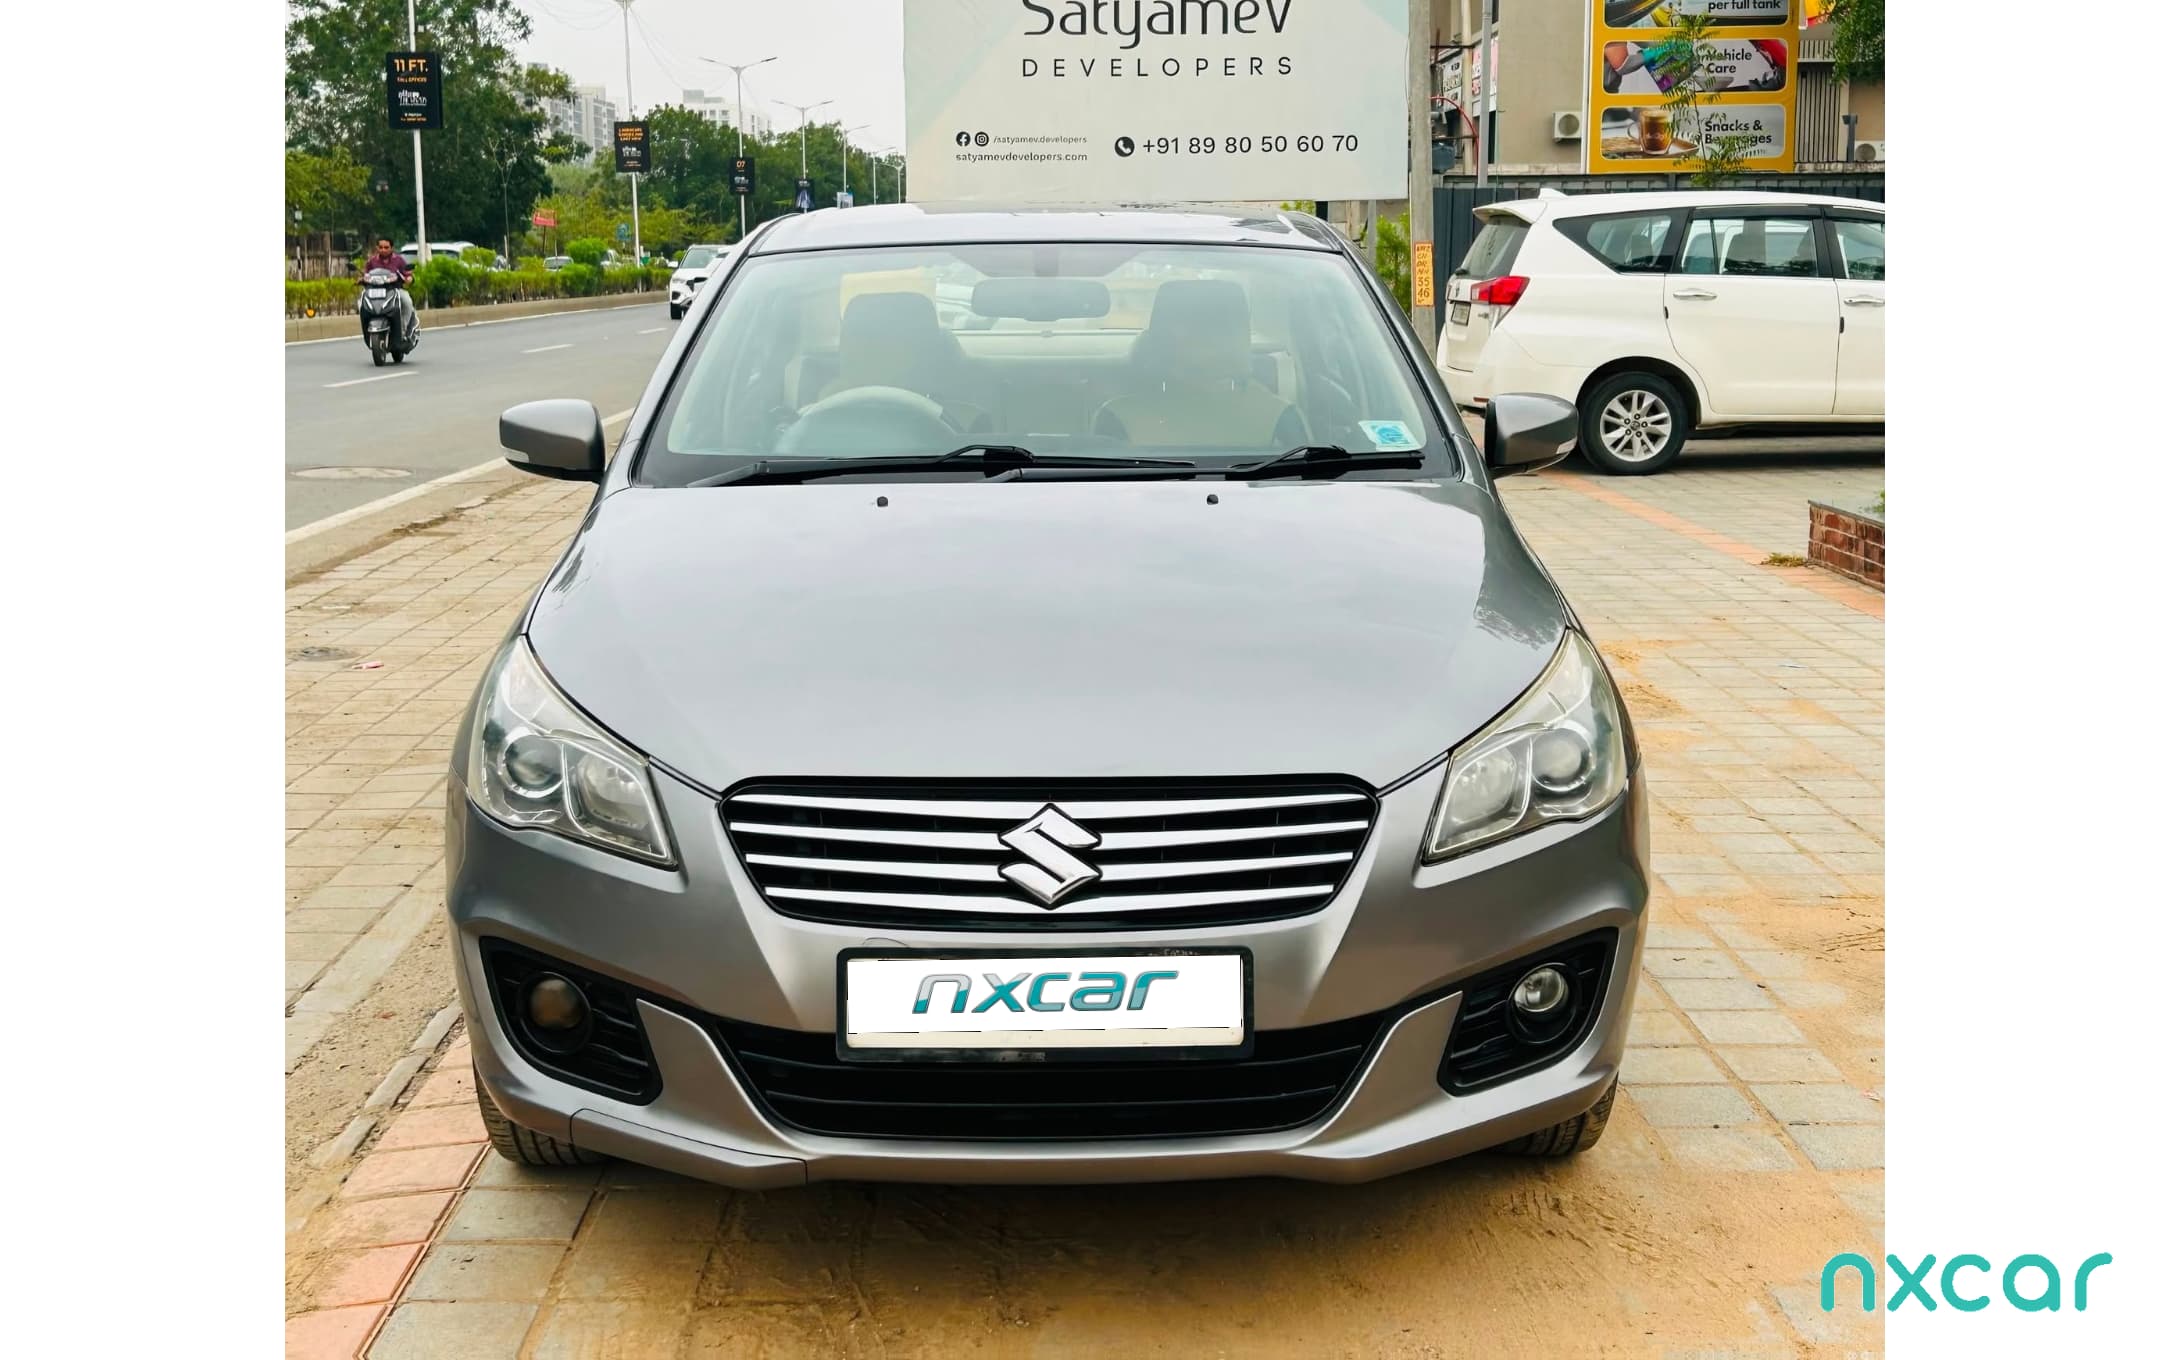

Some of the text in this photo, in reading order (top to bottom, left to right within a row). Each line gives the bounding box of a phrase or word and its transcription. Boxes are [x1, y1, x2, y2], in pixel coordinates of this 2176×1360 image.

[1708, 0, 1781, 13] per full tank
[1707, 48, 1752, 61] Vehicle
[394, 58, 429, 72] 11 FT.
[1022, 57, 1292, 77] DEVELOPERS
[1707, 62, 1737, 73] Care
[1704, 119, 1764, 132] Snacks &
[1142, 134, 1358, 154] +91 89 80 50 60 70
[955, 151, 1088, 163] satyamevdevelopers.com
[1417, 287, 1430, 298] 46
